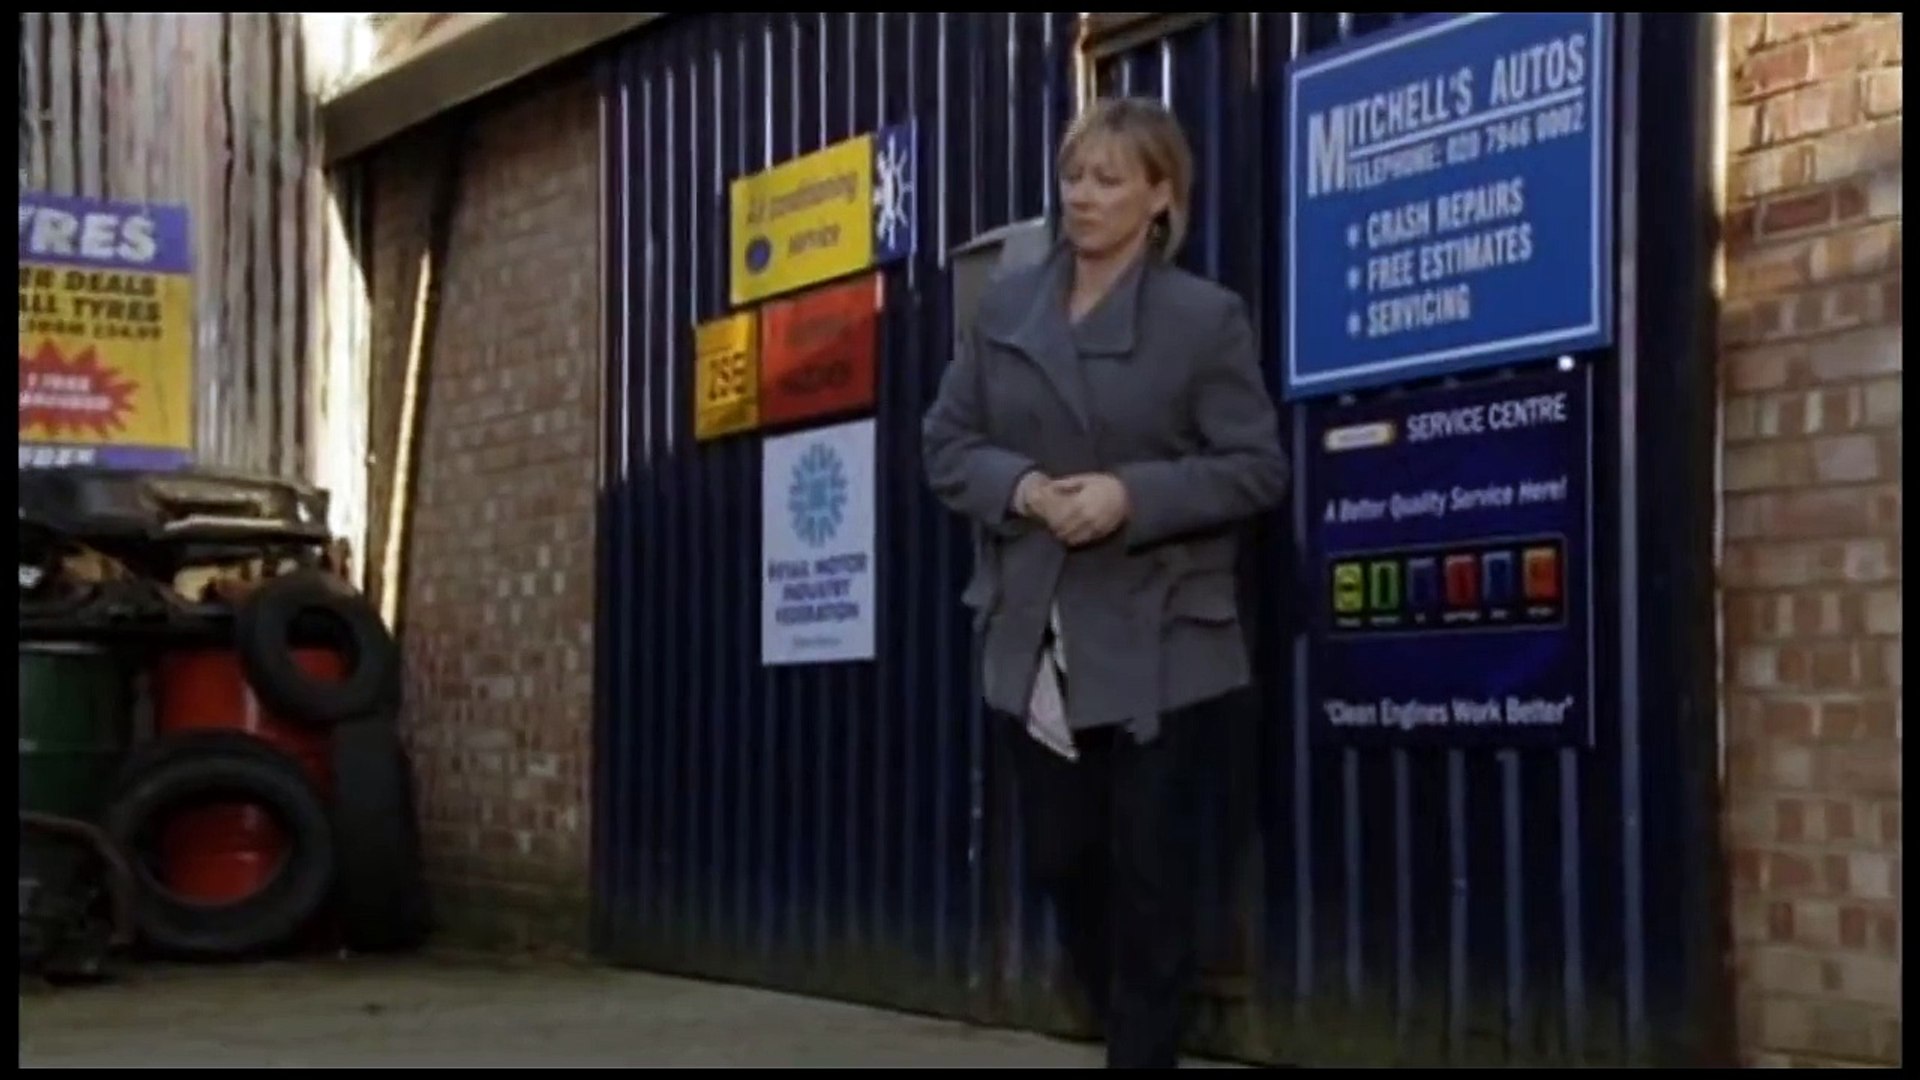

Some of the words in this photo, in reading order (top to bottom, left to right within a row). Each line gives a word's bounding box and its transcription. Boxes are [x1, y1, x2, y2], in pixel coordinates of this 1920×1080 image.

[1308, 66, 1473, 197] MITCHELL'S
[1490, 34, 1586, 106] AUTOS
[1367, 200, 1430, 249] CRASH
[1437, 176, 1525, 233] REPAIRS
[1367, 248, 1415, 292] FREE
[1419, 221, 1533, 282] ESTIMATES
[74, 296, 163, 324] TYRES
[1367, 283, 1470, 338] SERVICING
[1406, 404, 1485, 443] SERVICE
[1488, 392, 1568, 430] CENTRE
[1324, 498, 1336, 523] A
[1390, 491, 1446, 522] Quality
[1450, 484, 1514, 512] Service
[1380, 697, 1449, 731] Engines
[1451, 697, 1502, 726] Work
